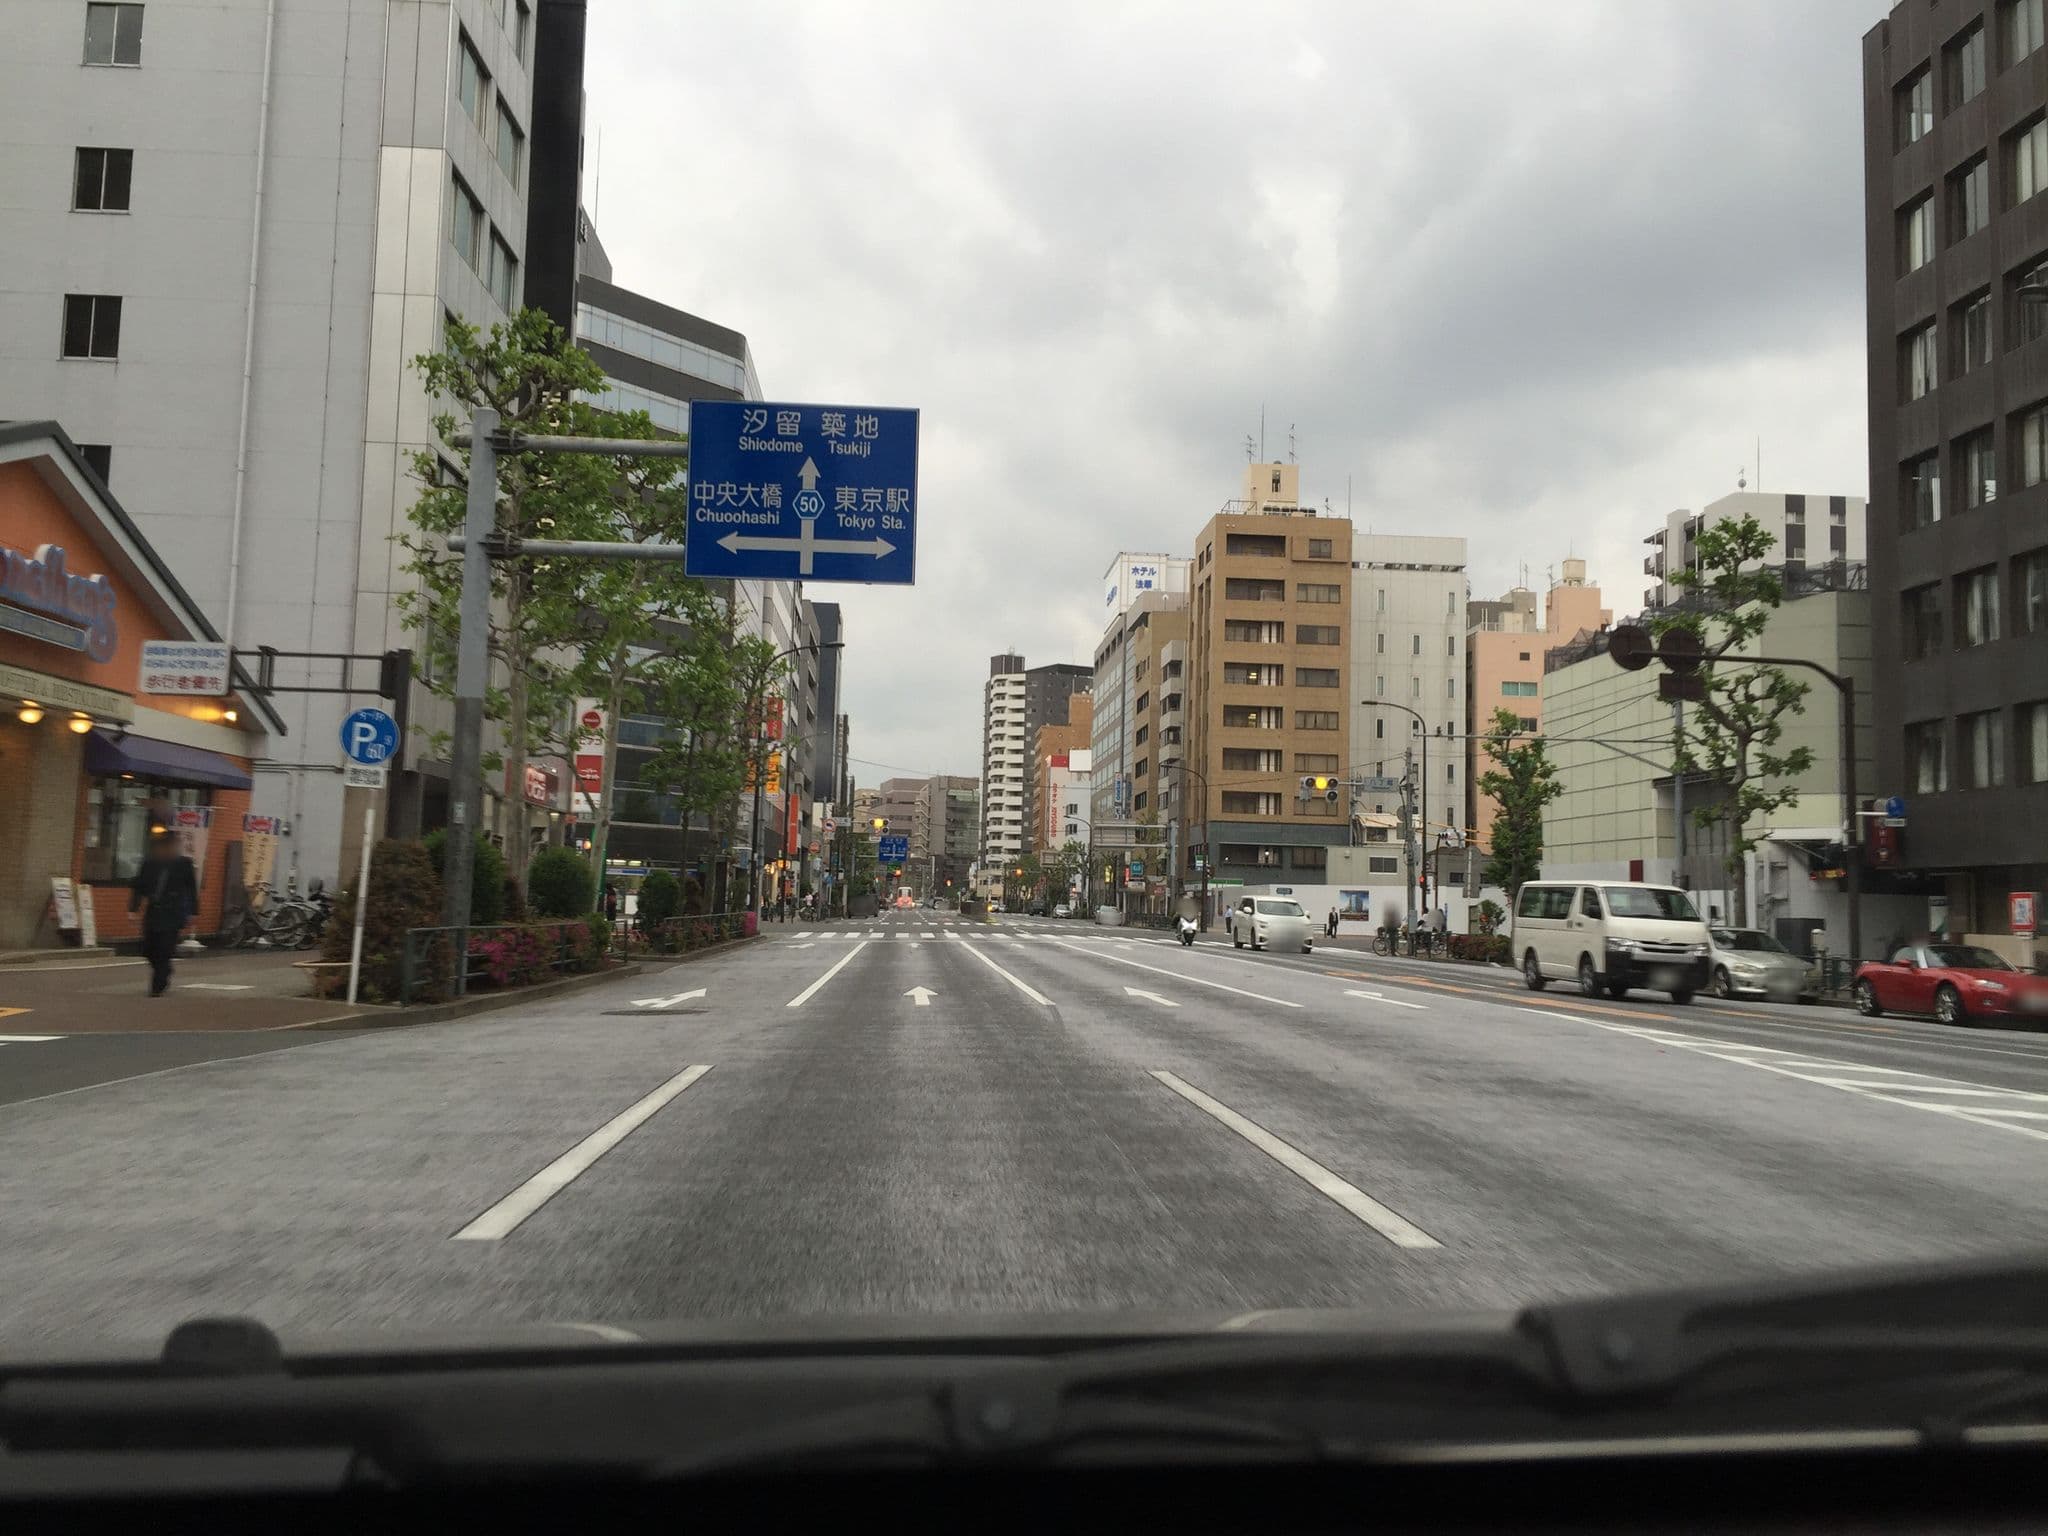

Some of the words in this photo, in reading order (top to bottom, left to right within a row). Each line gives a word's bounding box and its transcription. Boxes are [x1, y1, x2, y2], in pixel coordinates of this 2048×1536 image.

[742, 408, 801, 436] 汐留
[820, 411, 879, 439] 築地
[739, 436, 804, 453] Shiodome
[828, 440, 871, 458] Tsukiji
[694, 480, 782, 509] 中央大橋
[799, 497, 818, 513] 50
[834, 486, 910, 513] 東京駅
[695, 508, 780, 525] Chuoohashi
[837, 513, 875, 531] Tokyo
[881, 516, 906, 530] Sta.
[1131, 566, 1157, 576] ホテル
[351, 721, 377, 757] P
